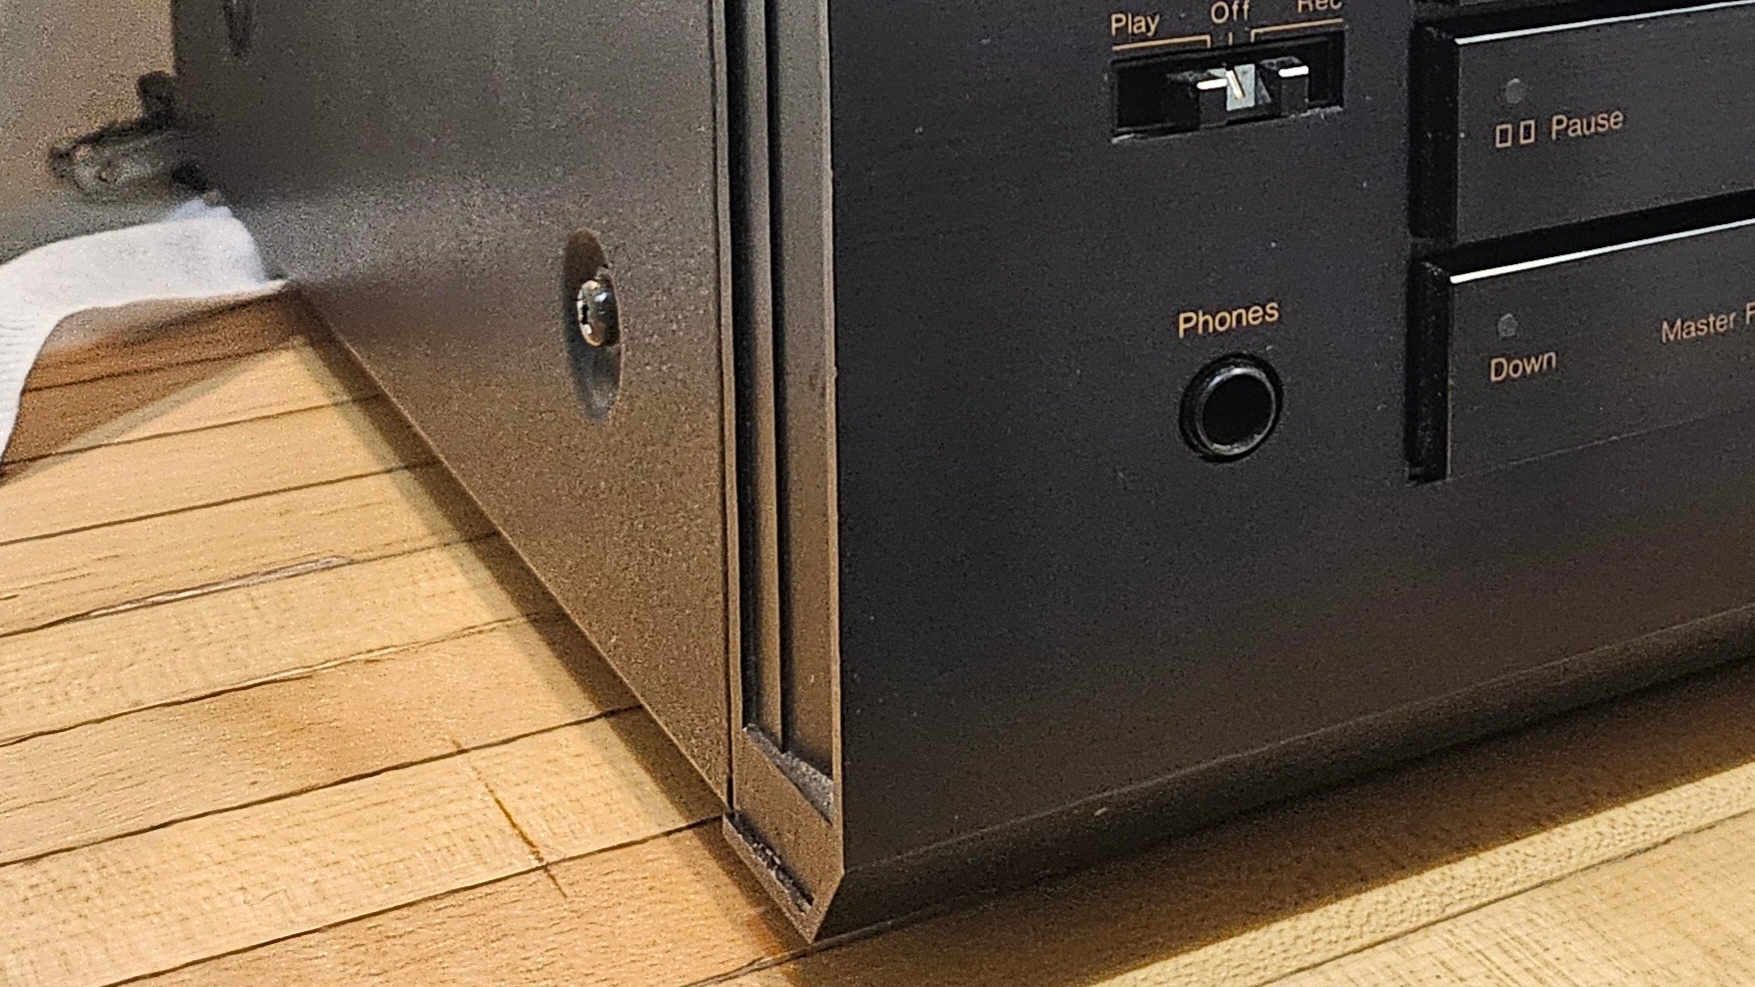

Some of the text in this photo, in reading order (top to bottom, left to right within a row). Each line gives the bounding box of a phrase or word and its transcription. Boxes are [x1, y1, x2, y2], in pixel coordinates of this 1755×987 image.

[1110, 12, 1161, 40] Play
[1210, 0, 1252, 25] Off
[1550, 108, 1624, 140] Pause
[1176, 300, 1281, 340] Phones
[1660, 313, 1738, 345] Master
[1489, 350, 1558, 384] Down
